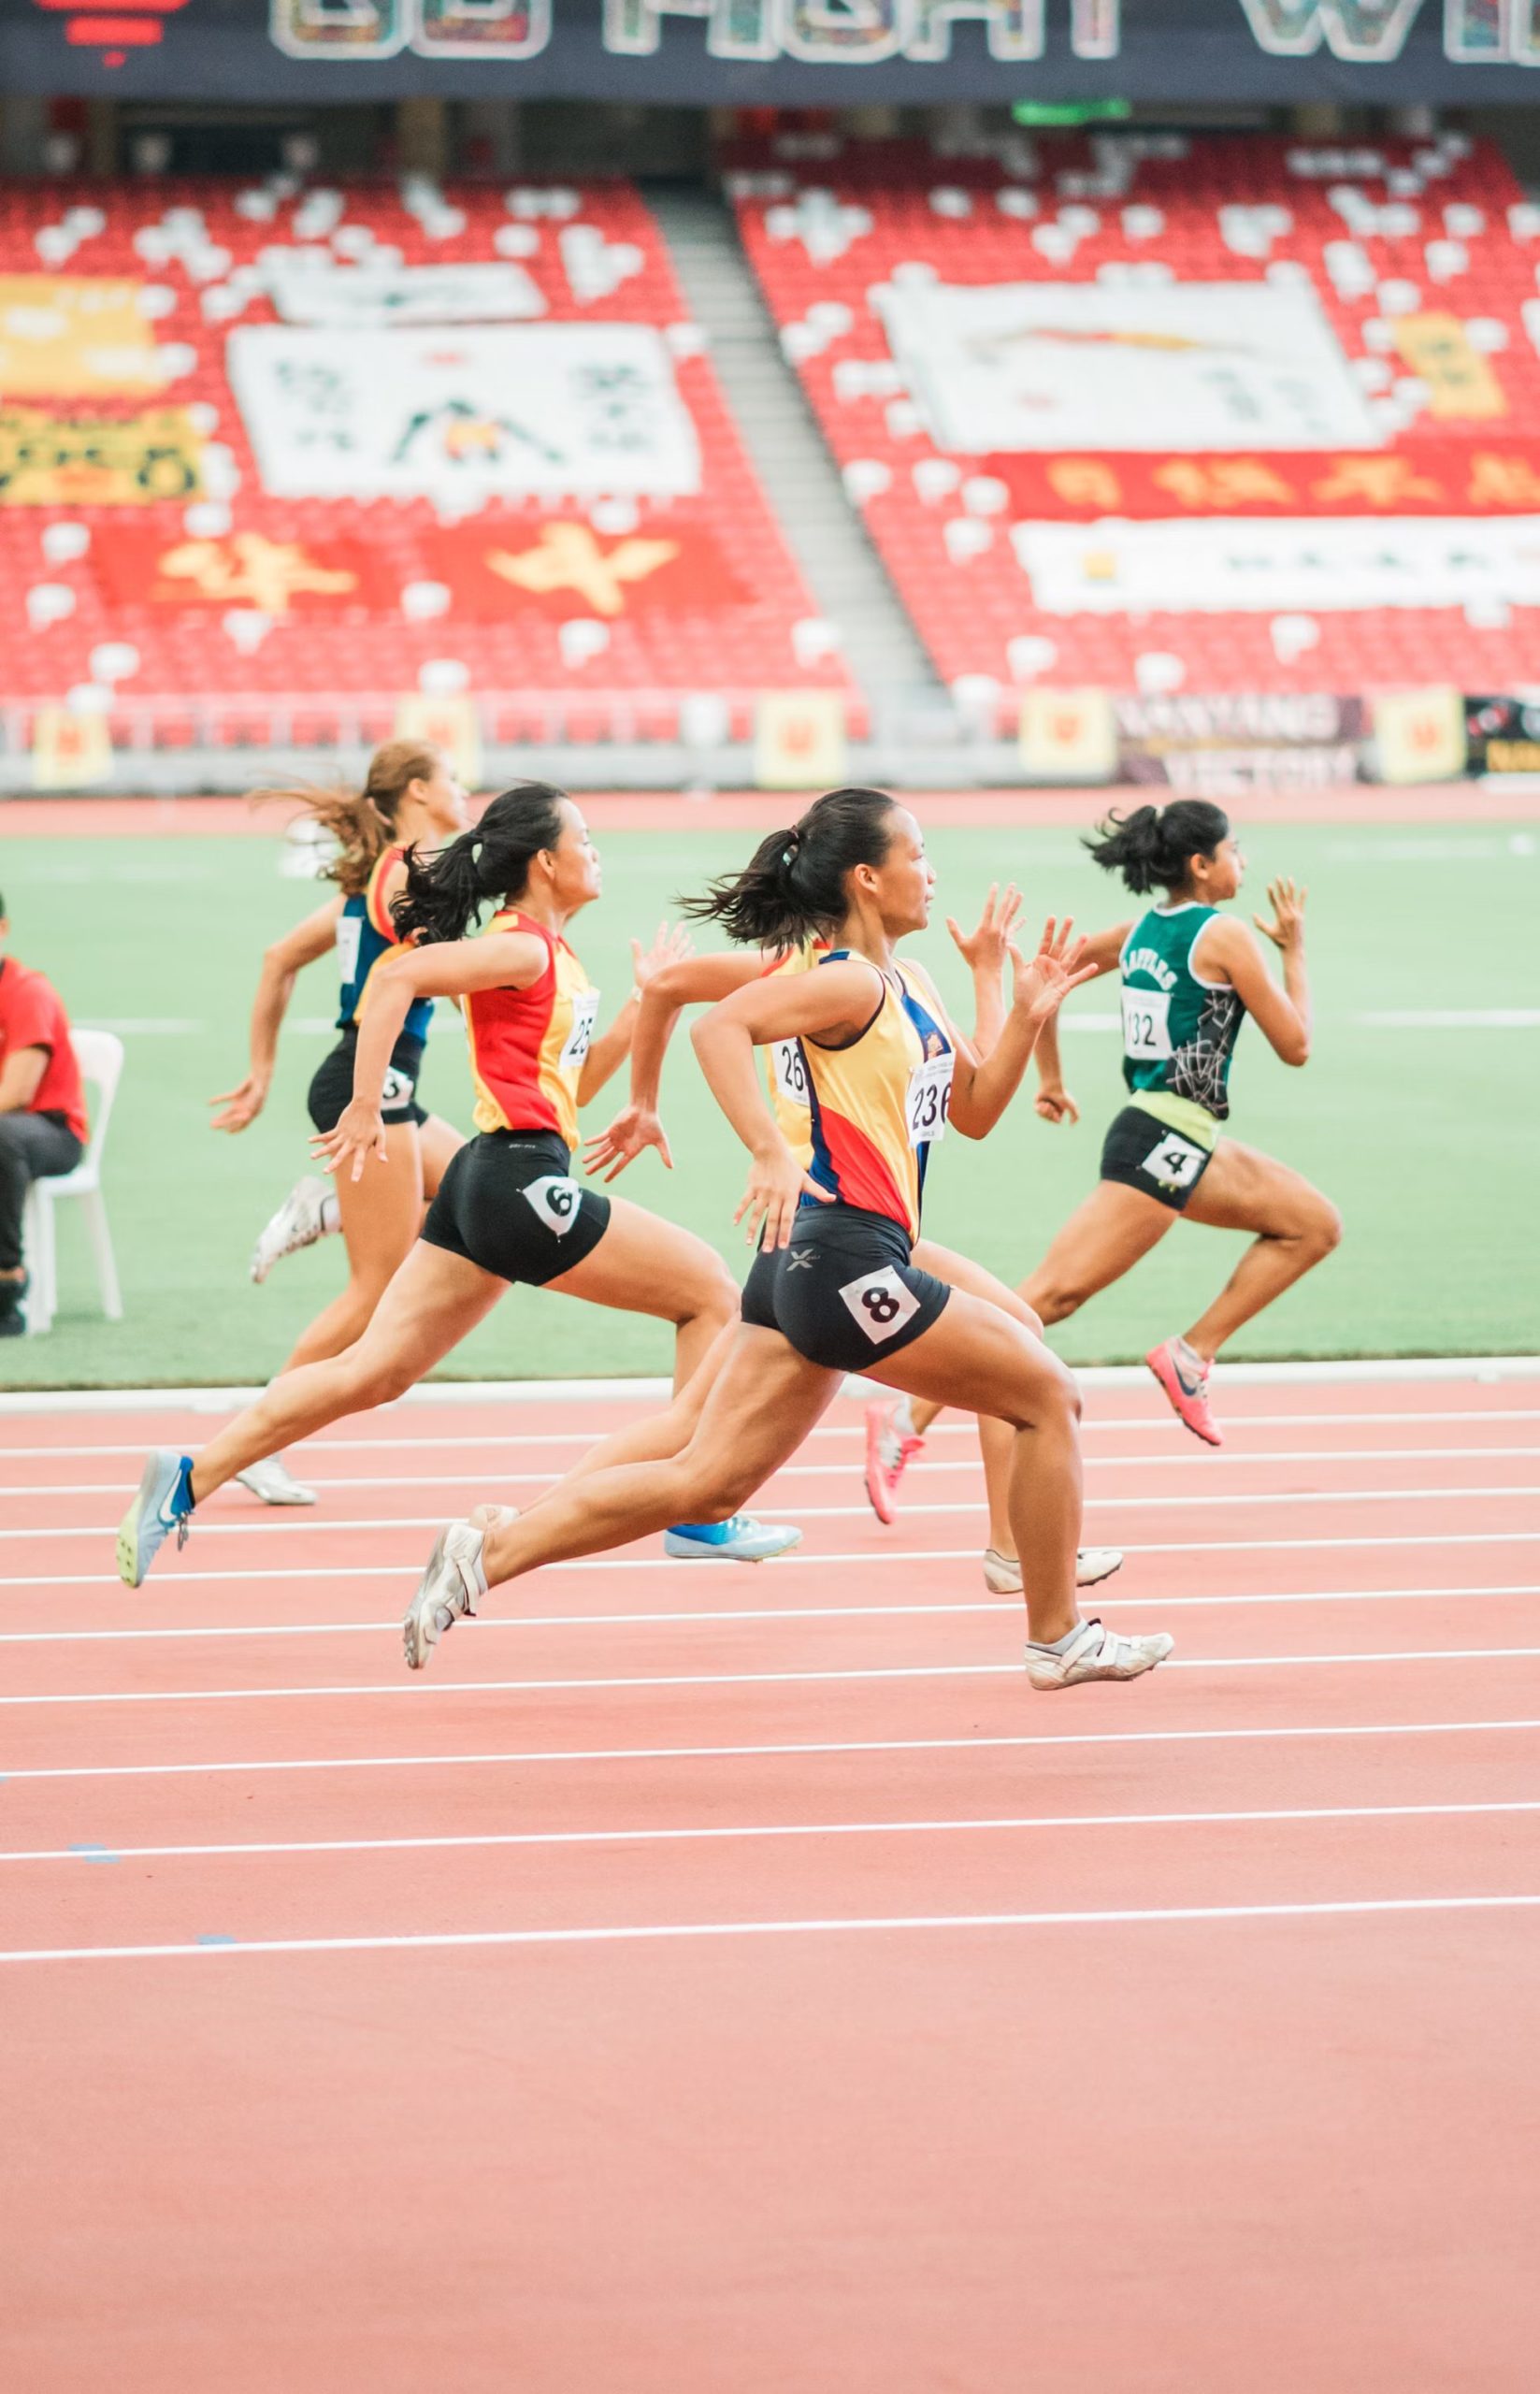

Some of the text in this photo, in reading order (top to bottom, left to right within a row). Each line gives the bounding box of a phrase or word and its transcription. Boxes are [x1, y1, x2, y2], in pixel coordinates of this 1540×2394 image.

[782, 1046, 808, 1092] 26
[1161, 1152, 1187, 1175] 4
[546, 1185, 573, 1218] 6
[861, 1287, 900, 1323] 8
